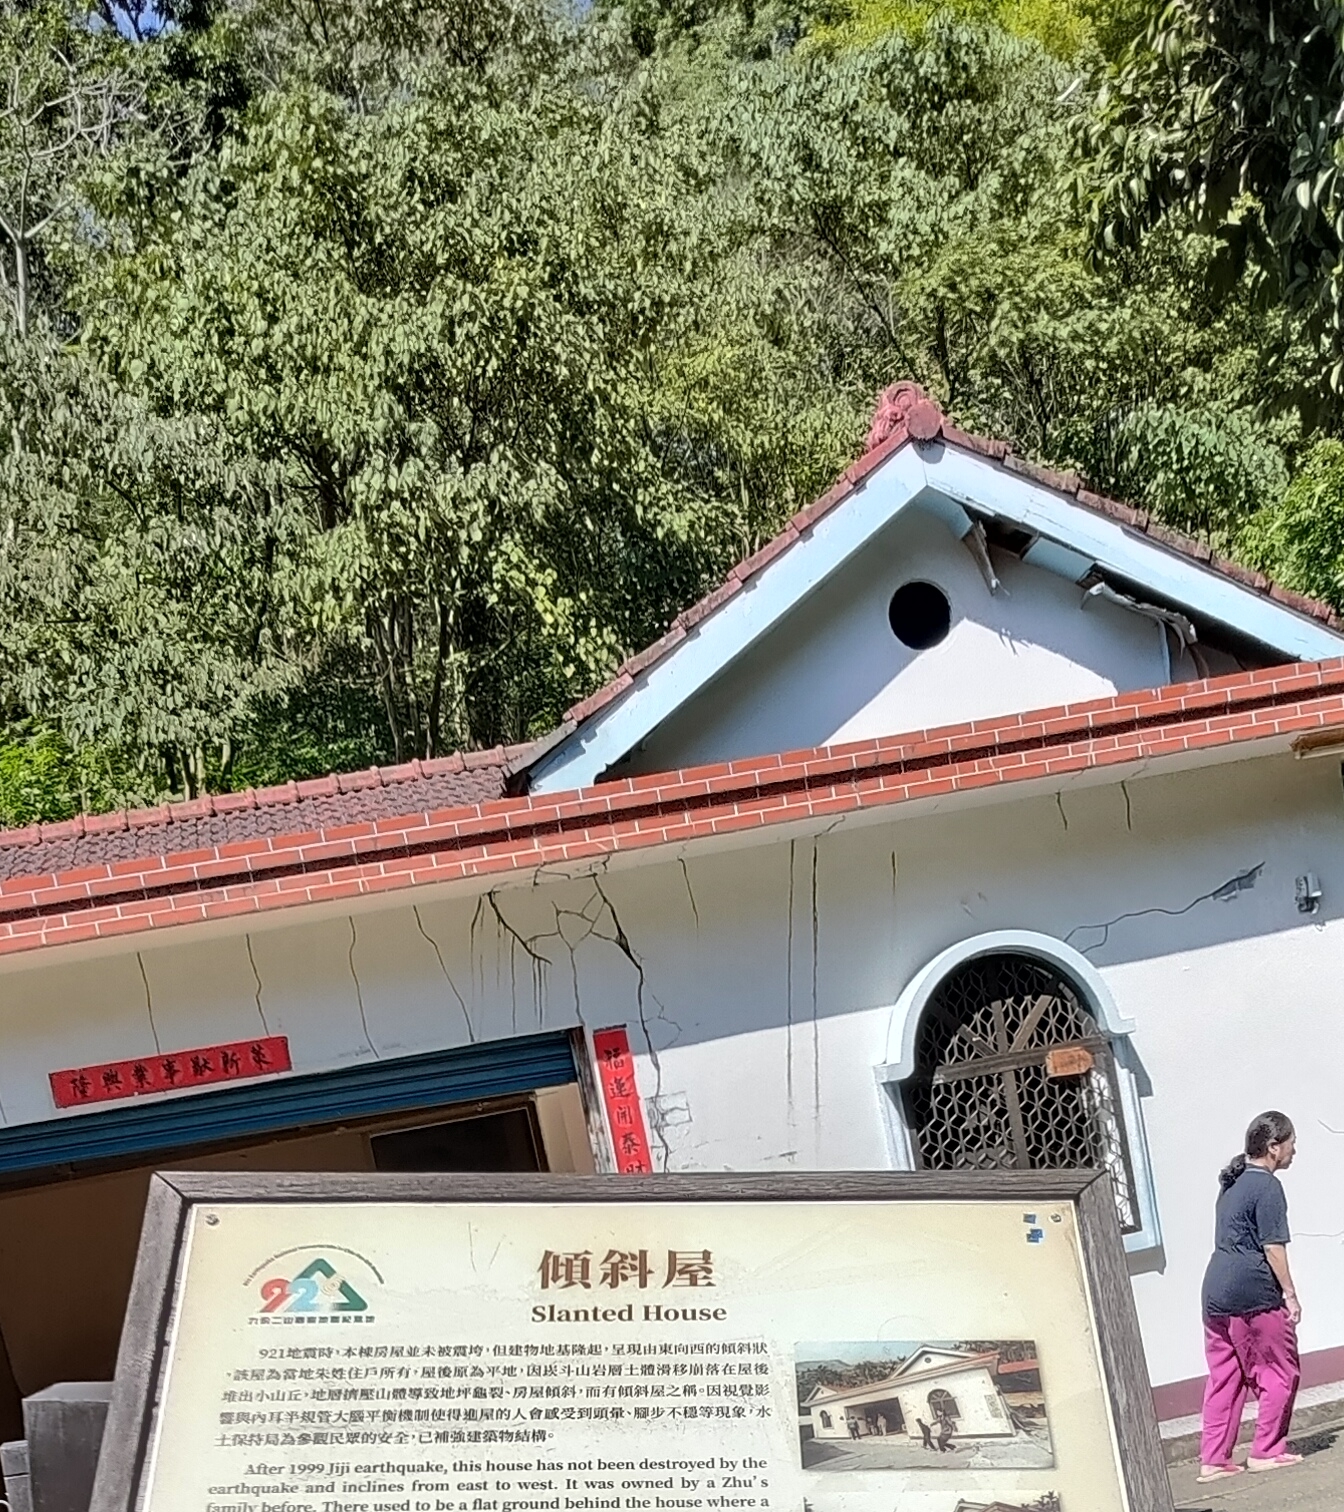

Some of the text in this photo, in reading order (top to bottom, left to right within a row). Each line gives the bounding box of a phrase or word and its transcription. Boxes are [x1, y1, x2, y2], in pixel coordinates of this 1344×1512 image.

[537, 1249, 717, 1290] 傾斜屋
[531, 1304, 728, 1323] Slanted House
[244, 1454, 768, 1478] After 1999 Jiji earthquake, this house has not been destroyed by the
[208, 1480, 300, 1498] earthquake
[304, 1479, 336, 1494] and
[342, 1478, 405, 1493] inclines
[411, 1478, 450, 1492] from
[456, 1478, 489, 1492] east
[495, 1478, 511, 1491] to
[517, 1477, 558, 1491] west.
[565, 1476, 578, 1490] It
[584, 1479, 615, 1490] was
[620, 1475, 674, 1489] owned
[680, 1474, 700, 1491] by
[706, 1478, 716, 1488] a
[321, 1498, 369, 1512] There
[373, 1498, 411, 1512] used
[415, 1499, 431, 1512] to
[435, 1497, 455, 1512] be
[458, 1501, 468, 1511] a
[471, 1497, 498, 1511] flat
[564, 1495, 621, 1510] behind
[625, 1495, 652, 1509] the
[655, 1494, 703, 1508] house
[706, 1493, 756, 1508] where
[760, 1497, 770, 1507] a
